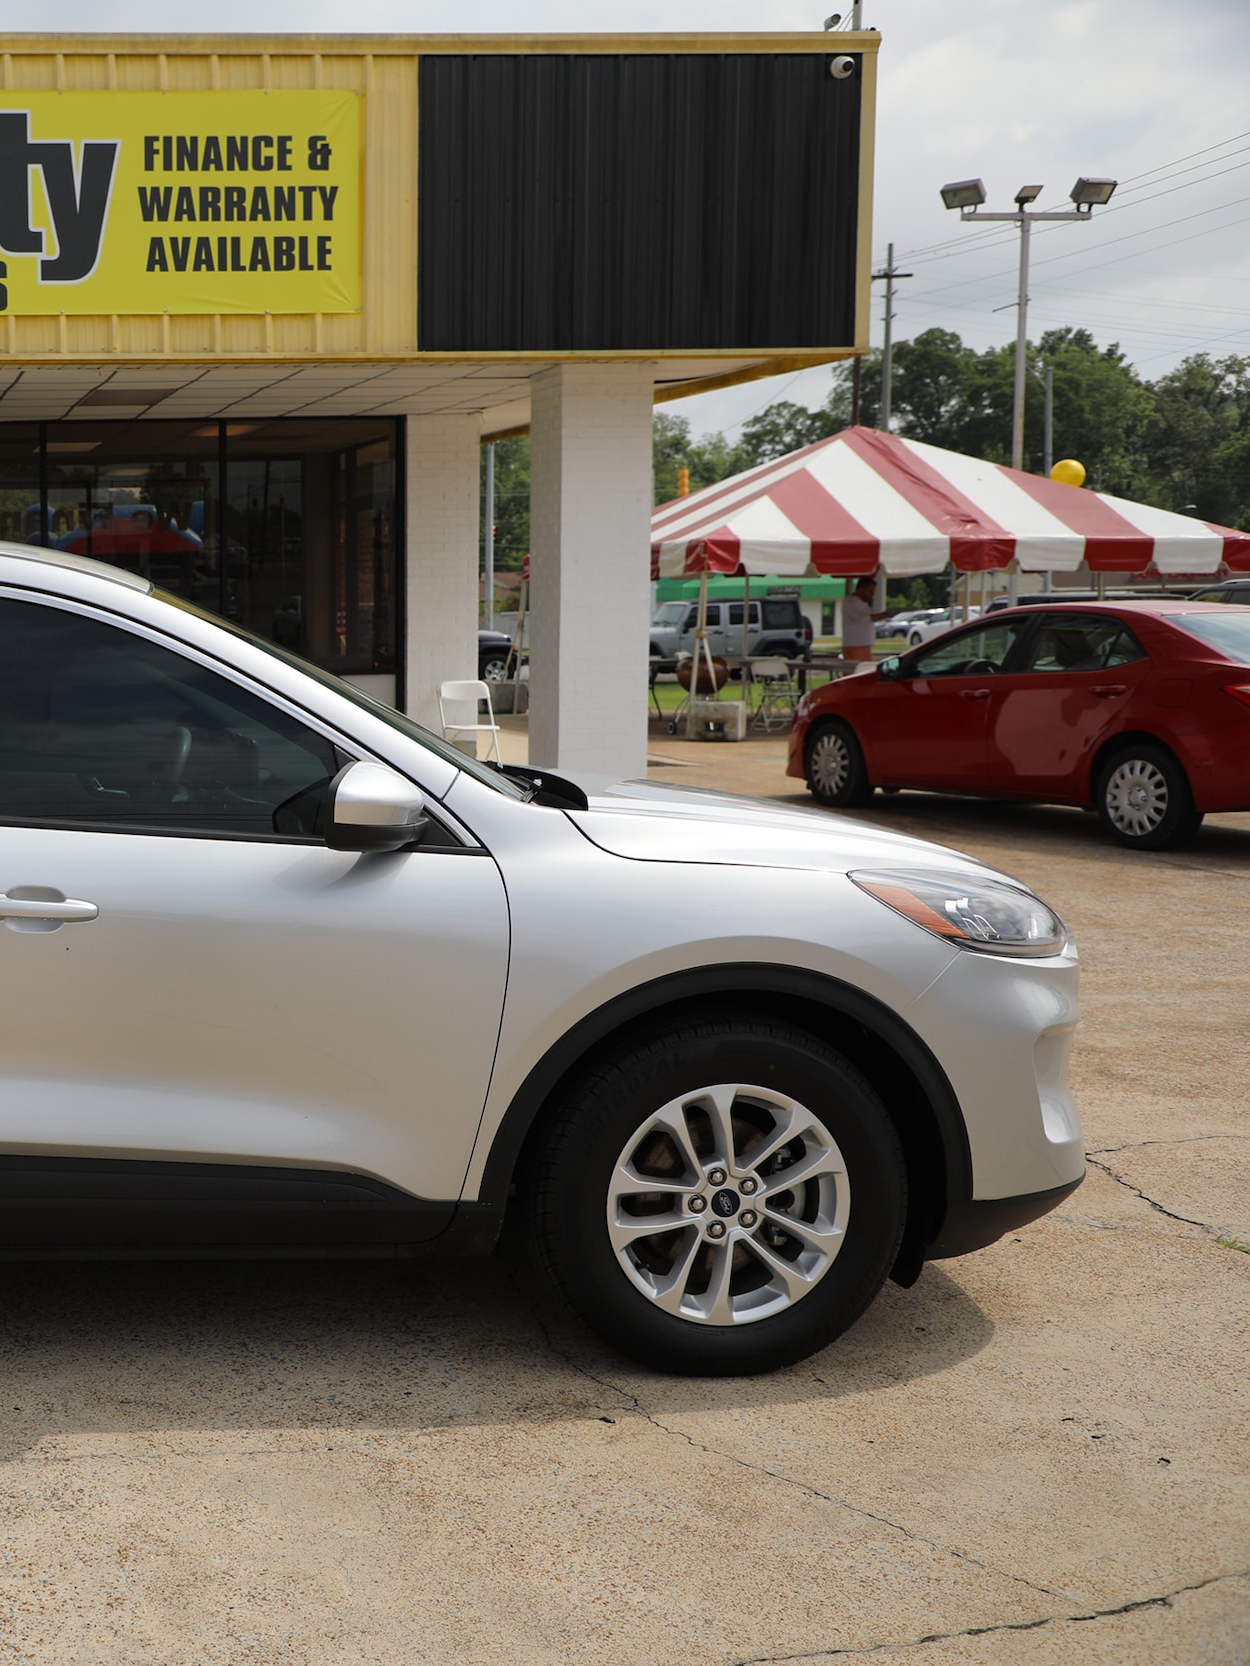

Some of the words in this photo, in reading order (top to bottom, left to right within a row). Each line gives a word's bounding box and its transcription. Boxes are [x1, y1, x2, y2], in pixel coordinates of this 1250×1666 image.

[144, 135, 293, 171] FINANCE
[308, 135, 333, 171] &
[137, 186, 339, 222] WARRANTY
[146, 236, 333, 272] AVAILABLE
